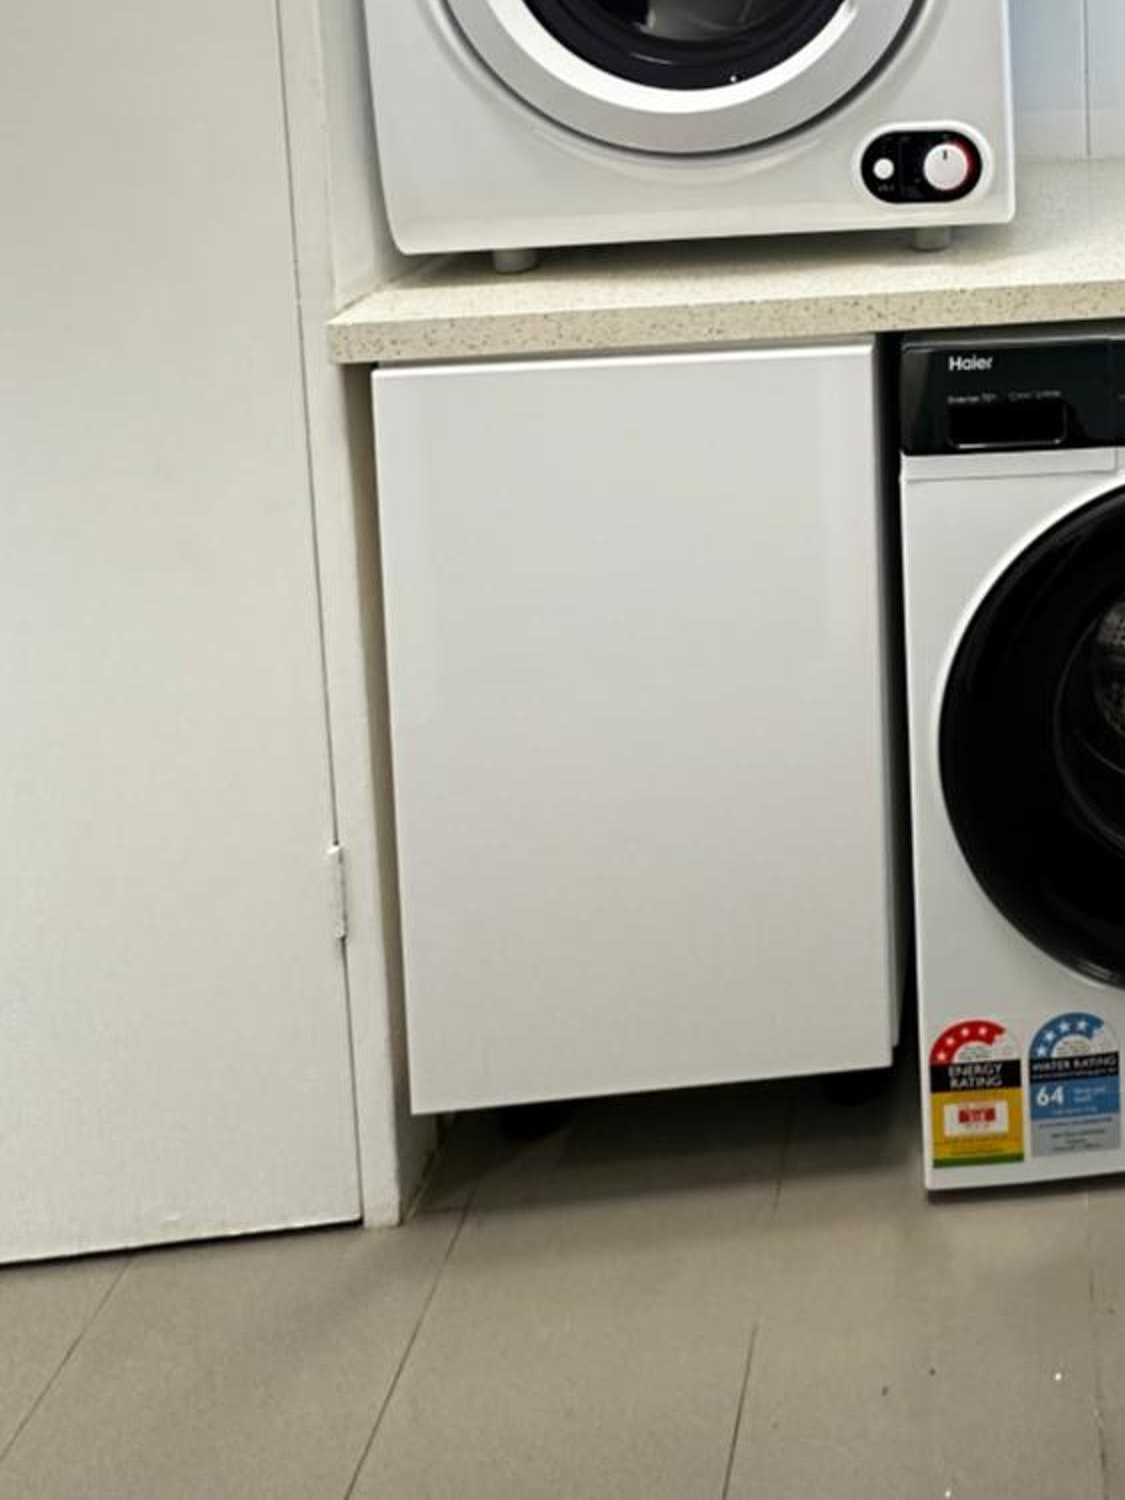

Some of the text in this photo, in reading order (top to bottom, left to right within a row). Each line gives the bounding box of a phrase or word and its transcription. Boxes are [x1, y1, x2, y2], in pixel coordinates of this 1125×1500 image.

[949, 354, 993, 371] Haier
[948, 1063, 1002, 1077] ENERGY
[949, 1076, 1002, 1089] RATING
[1037, 1085, 1064, 1107] 64
